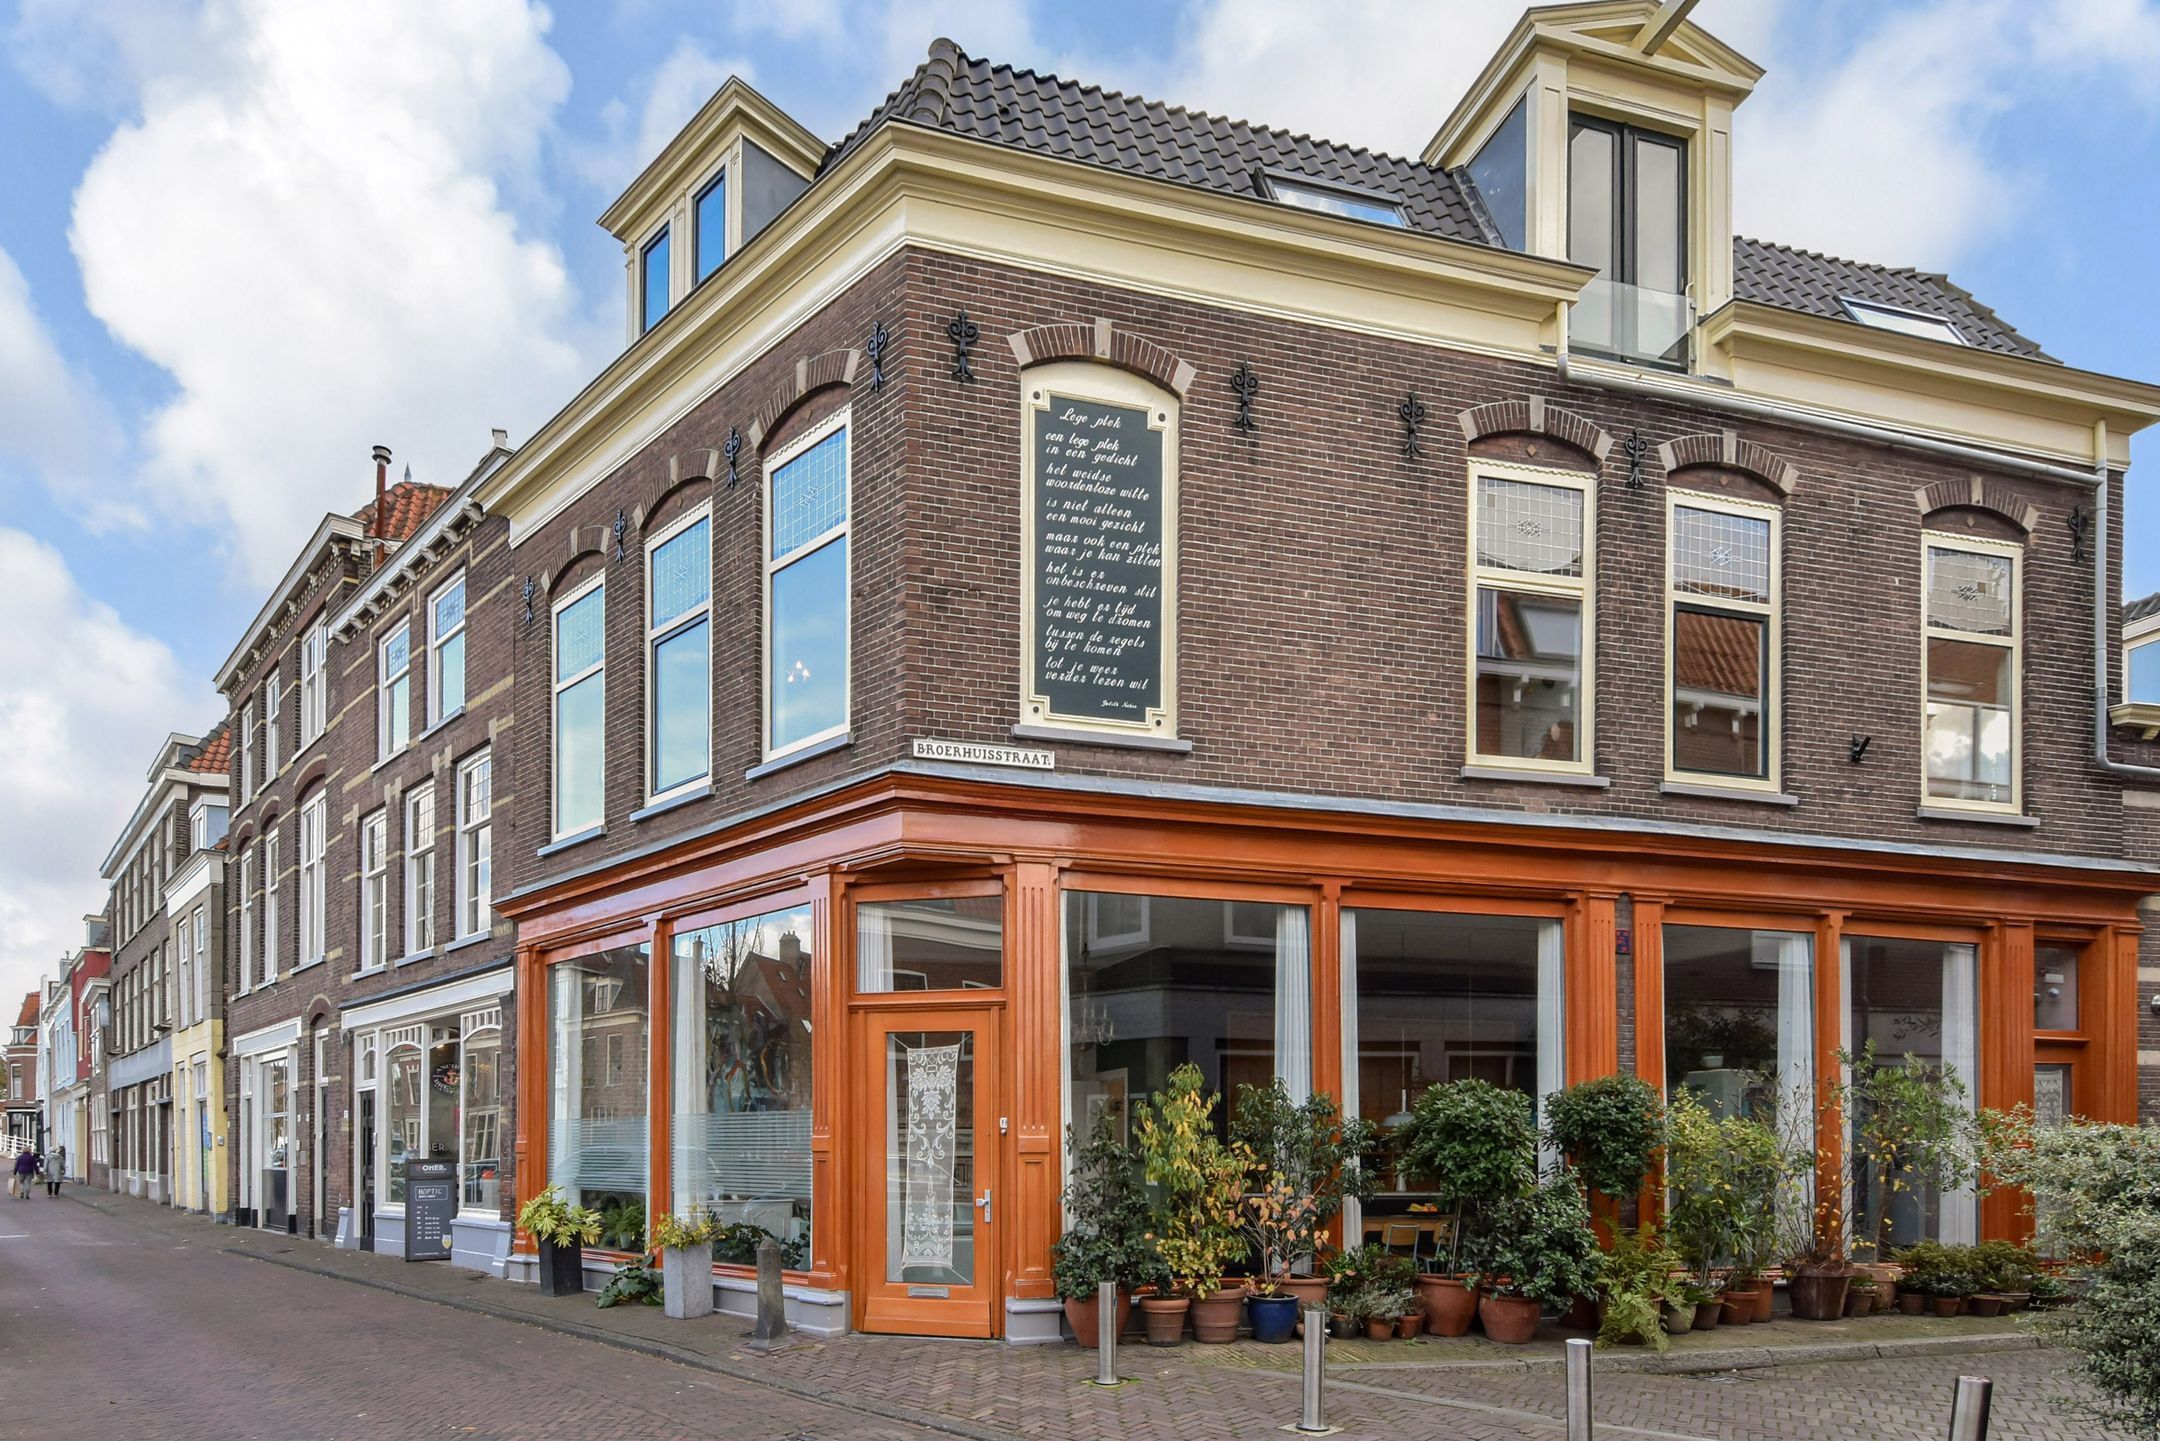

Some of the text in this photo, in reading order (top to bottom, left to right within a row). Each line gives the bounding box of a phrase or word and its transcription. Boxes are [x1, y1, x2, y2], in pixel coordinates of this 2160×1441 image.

[1060, 408, 1121, 429] Lege plek
[1045, 432, 1120, 451] een lege plek
[1046, 444, 1138, 466] in een gedicht
[1046, 463, 1112, 482] het weidse
[1046, 479, 1149, 501] woordenloze witte
[1046, 498, 1132, 518] is niet alleen
[1046, 513, 1145, 533] een mooi gezicht
[1046, 533, 1160, 555] maar ook een plek
[1045, 546, 1161, 567] waar je kan zitten
[1046, 561, 1105, 579] het is er
[1046, 575, 1157, 598] onbeschreven stil
[1043, 596, 1059, 608] je
[1064, 596, 1090, 609] hebt
[1097, 603, 1111, 611] er
[1046, 608, 1151, 628] om weg te dromen
[1046, 625, 1145, 648] tussen de regels
[1065, 639, 1077, 651] te
[1083, 641, 1122, 656] komen
[1046, 656, 1119, 675] tot je weer
[1046, 672, 1149, 690] verder lezen wil
[428, 1143, 448, 1152] ER.
